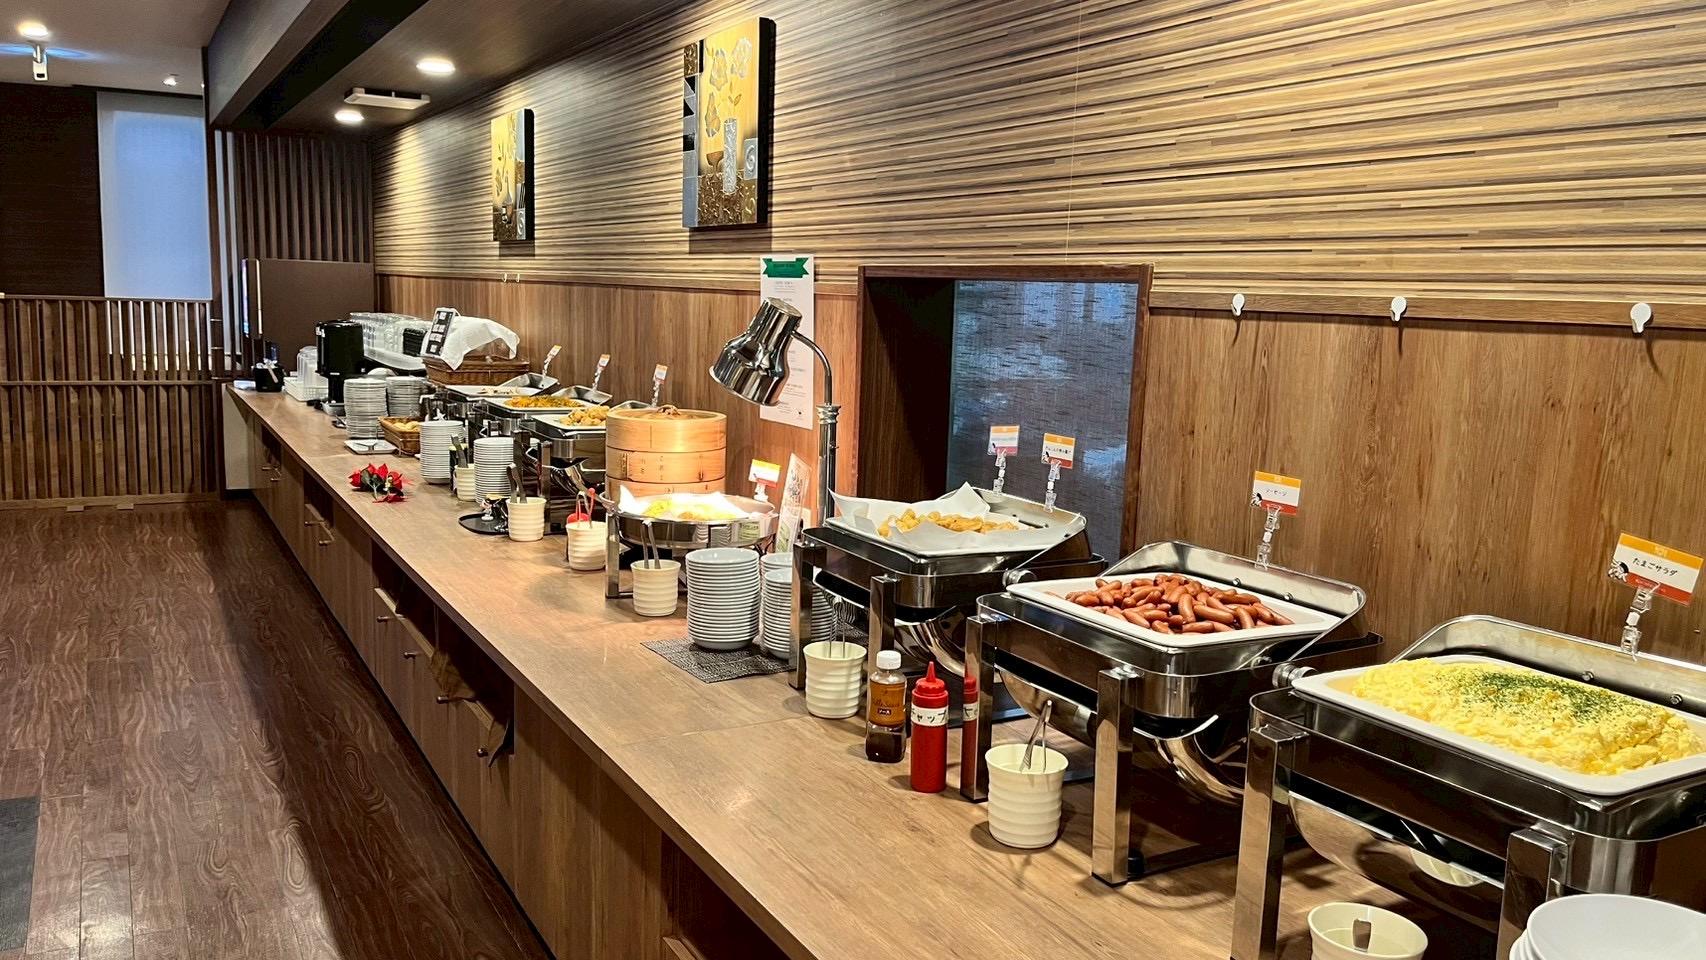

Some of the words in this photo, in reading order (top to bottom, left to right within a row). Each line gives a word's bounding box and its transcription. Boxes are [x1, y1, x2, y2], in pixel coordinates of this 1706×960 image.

[1632, 557, 1678, 576] たまごサラダ
